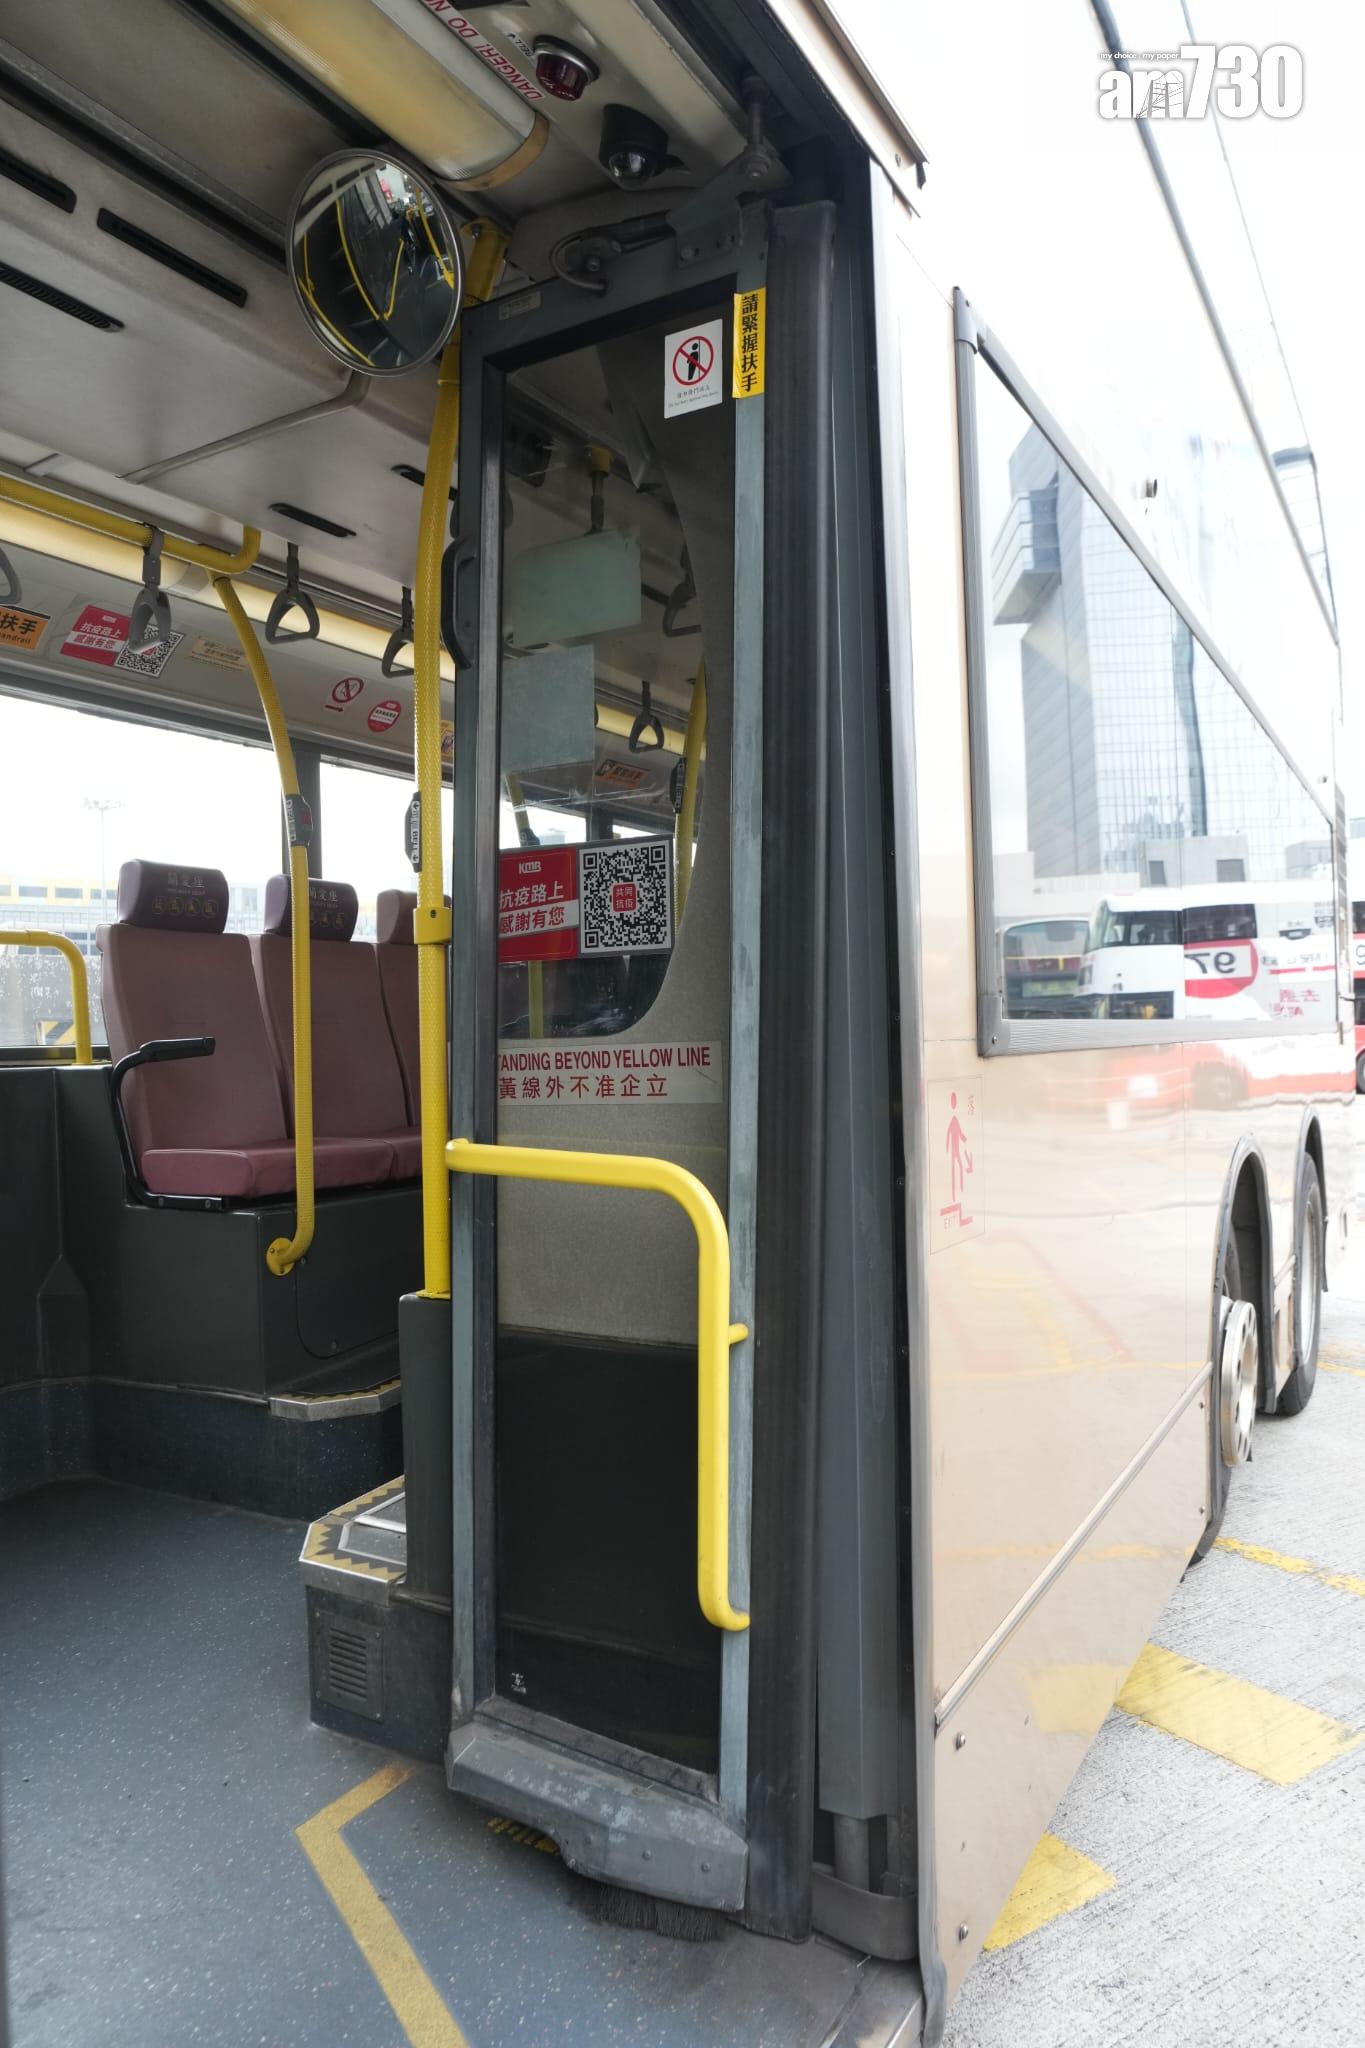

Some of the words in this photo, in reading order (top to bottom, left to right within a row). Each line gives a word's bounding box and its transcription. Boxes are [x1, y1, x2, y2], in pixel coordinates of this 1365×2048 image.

[448, 17, 479, 38] DO
[473, 43, 544, 100] DANGER!
[741, 293, 759, 393] 請緊握扶手
[80, 622, 122, 639] 抗疫路上
[74, 635, 117, 650] 感謝有您
[518, 861, 542, 875] KMB
[499, 880, 565, 910] 抗疫路上
[615, 886, 633, 897] 共同
[615, 899, 634, 909] 抗疫
[500, 906, 565, 934] 感謝有您
[555, 1050, 611, 1070] BEYOND
[615, 1048, 673, 1068] YELLOW
[678, 1046, 711, 1066] LINE
